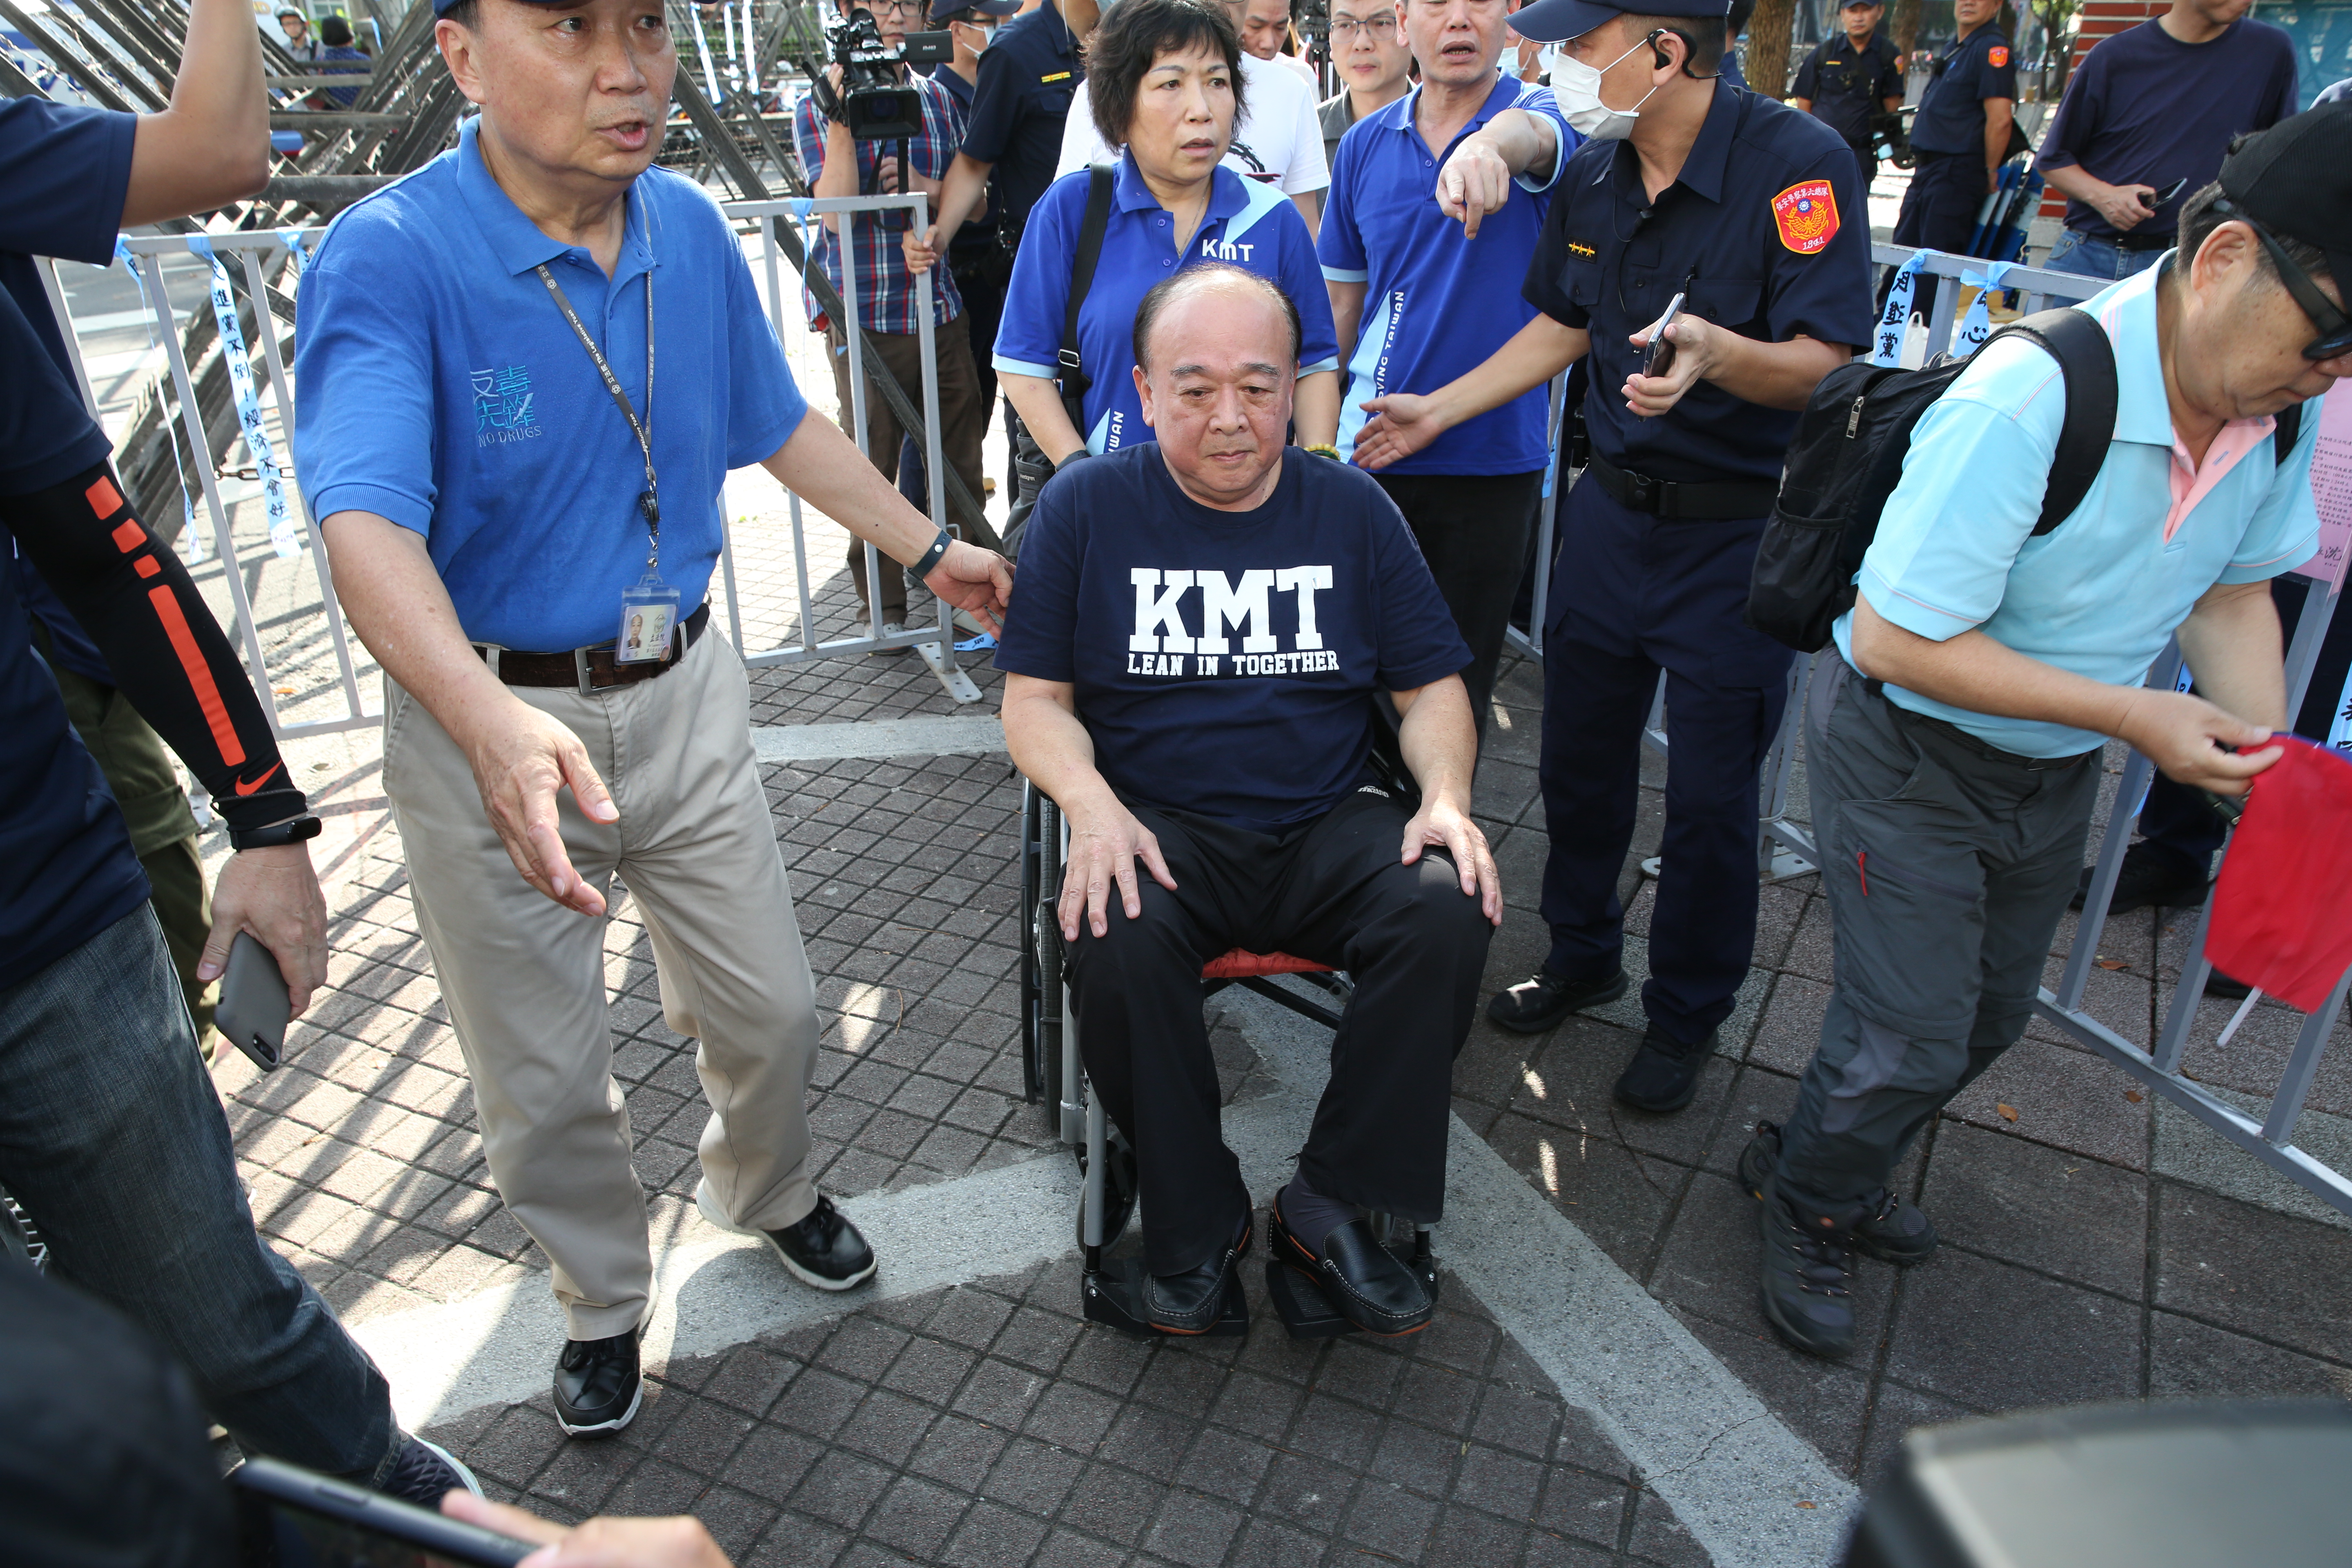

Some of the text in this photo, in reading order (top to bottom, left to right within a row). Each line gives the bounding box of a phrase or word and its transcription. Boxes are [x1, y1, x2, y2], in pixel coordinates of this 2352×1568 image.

[1775, 186, 1829, 212] 保安警察第六總隊
[1802, 236, 1825, 250] 1841
[568, 309, 615, 384] 立法院 The Legislative Yuan
[1375, 291, 1405, 412] OVING TAIWAN
[478, 425, 542, 448] NO DRUGS
[630, 413, 648, 452] egislative Yuan
[1129, 565, 1334, 655] KMT
[1127, 650, 1340, 676] LEAN IN TOGETHER
